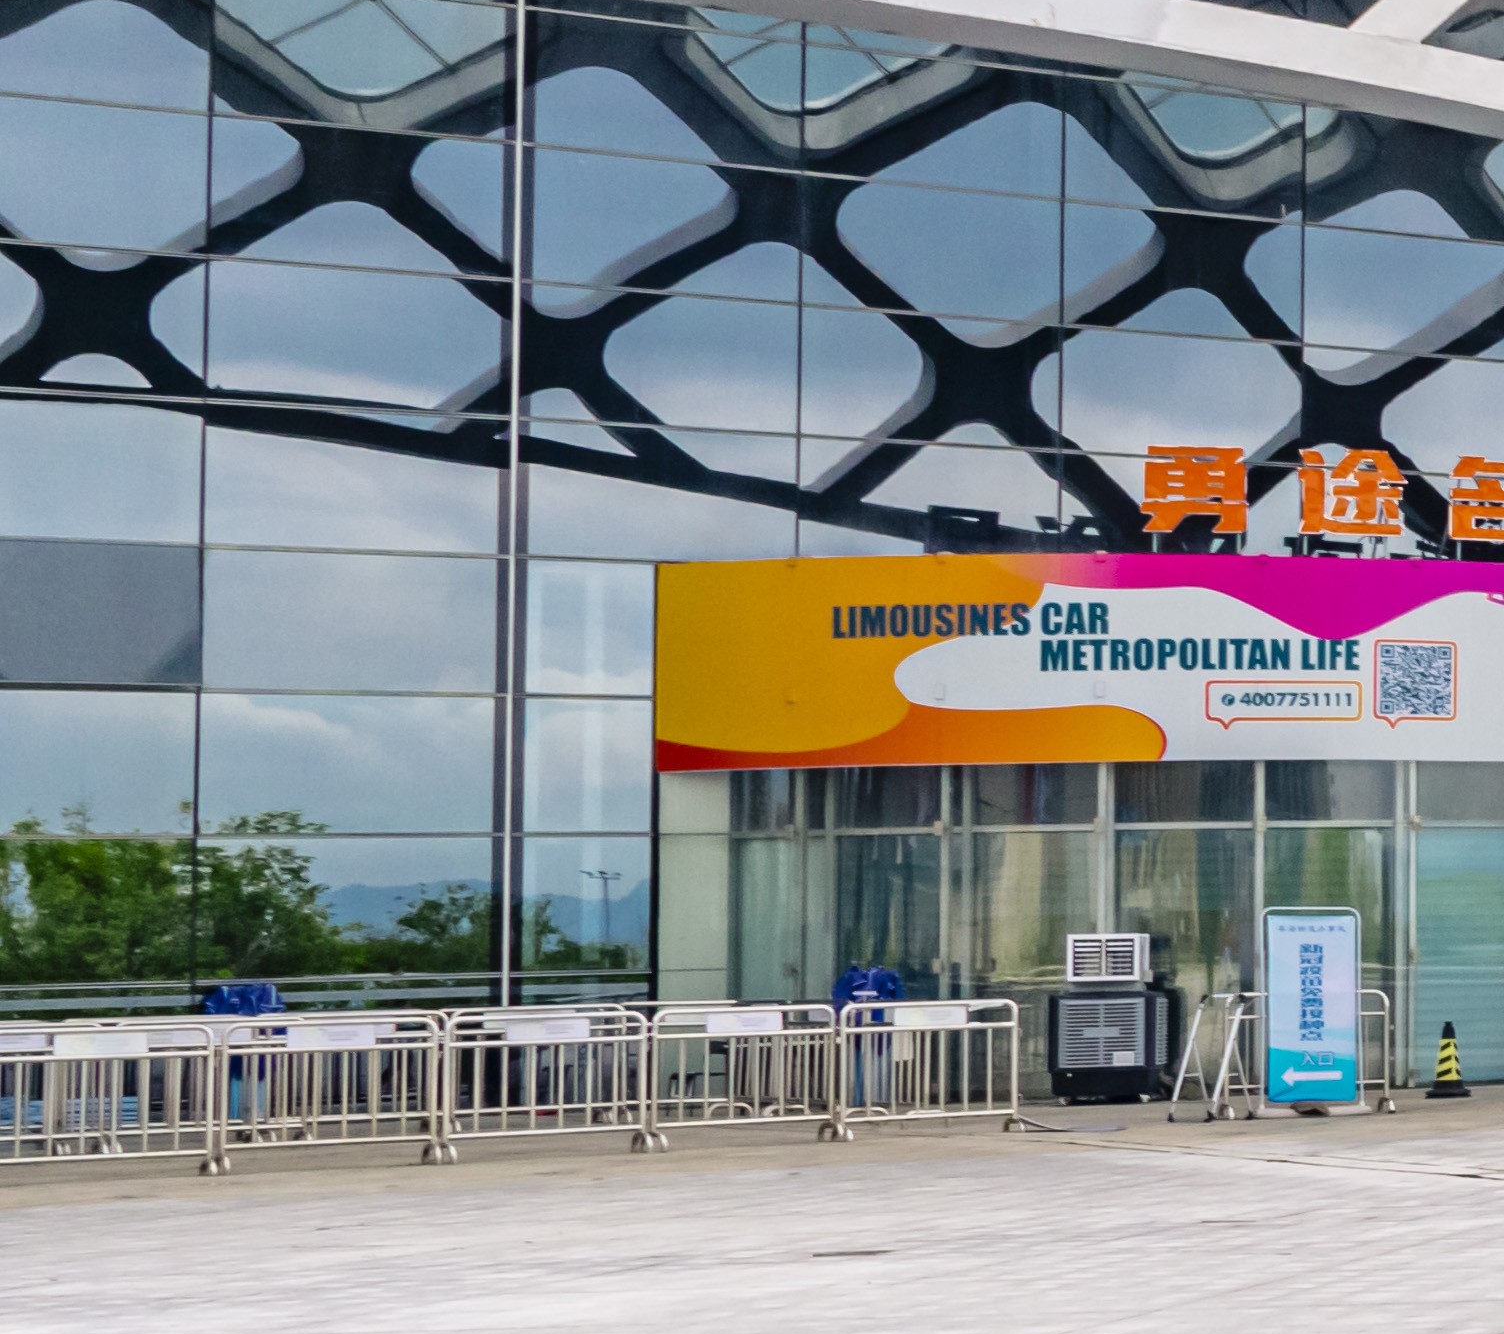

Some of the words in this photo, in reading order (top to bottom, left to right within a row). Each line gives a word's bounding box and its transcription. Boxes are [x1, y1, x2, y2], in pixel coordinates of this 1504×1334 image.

[831, 603, 1030, 638] LIMOUSINES
[1040, 602, 1110, 635] CAR
[1039, 639, 1291, 672] METROPOLITAN
[1300, 639, 1360, 671] LIFE
[1239, 691, 1353, 708] 4007751111
[1299, 943, 1324, 1041] 新冠疫苗免费接种点
[1301, 1051, 1335, 1066] 入口
